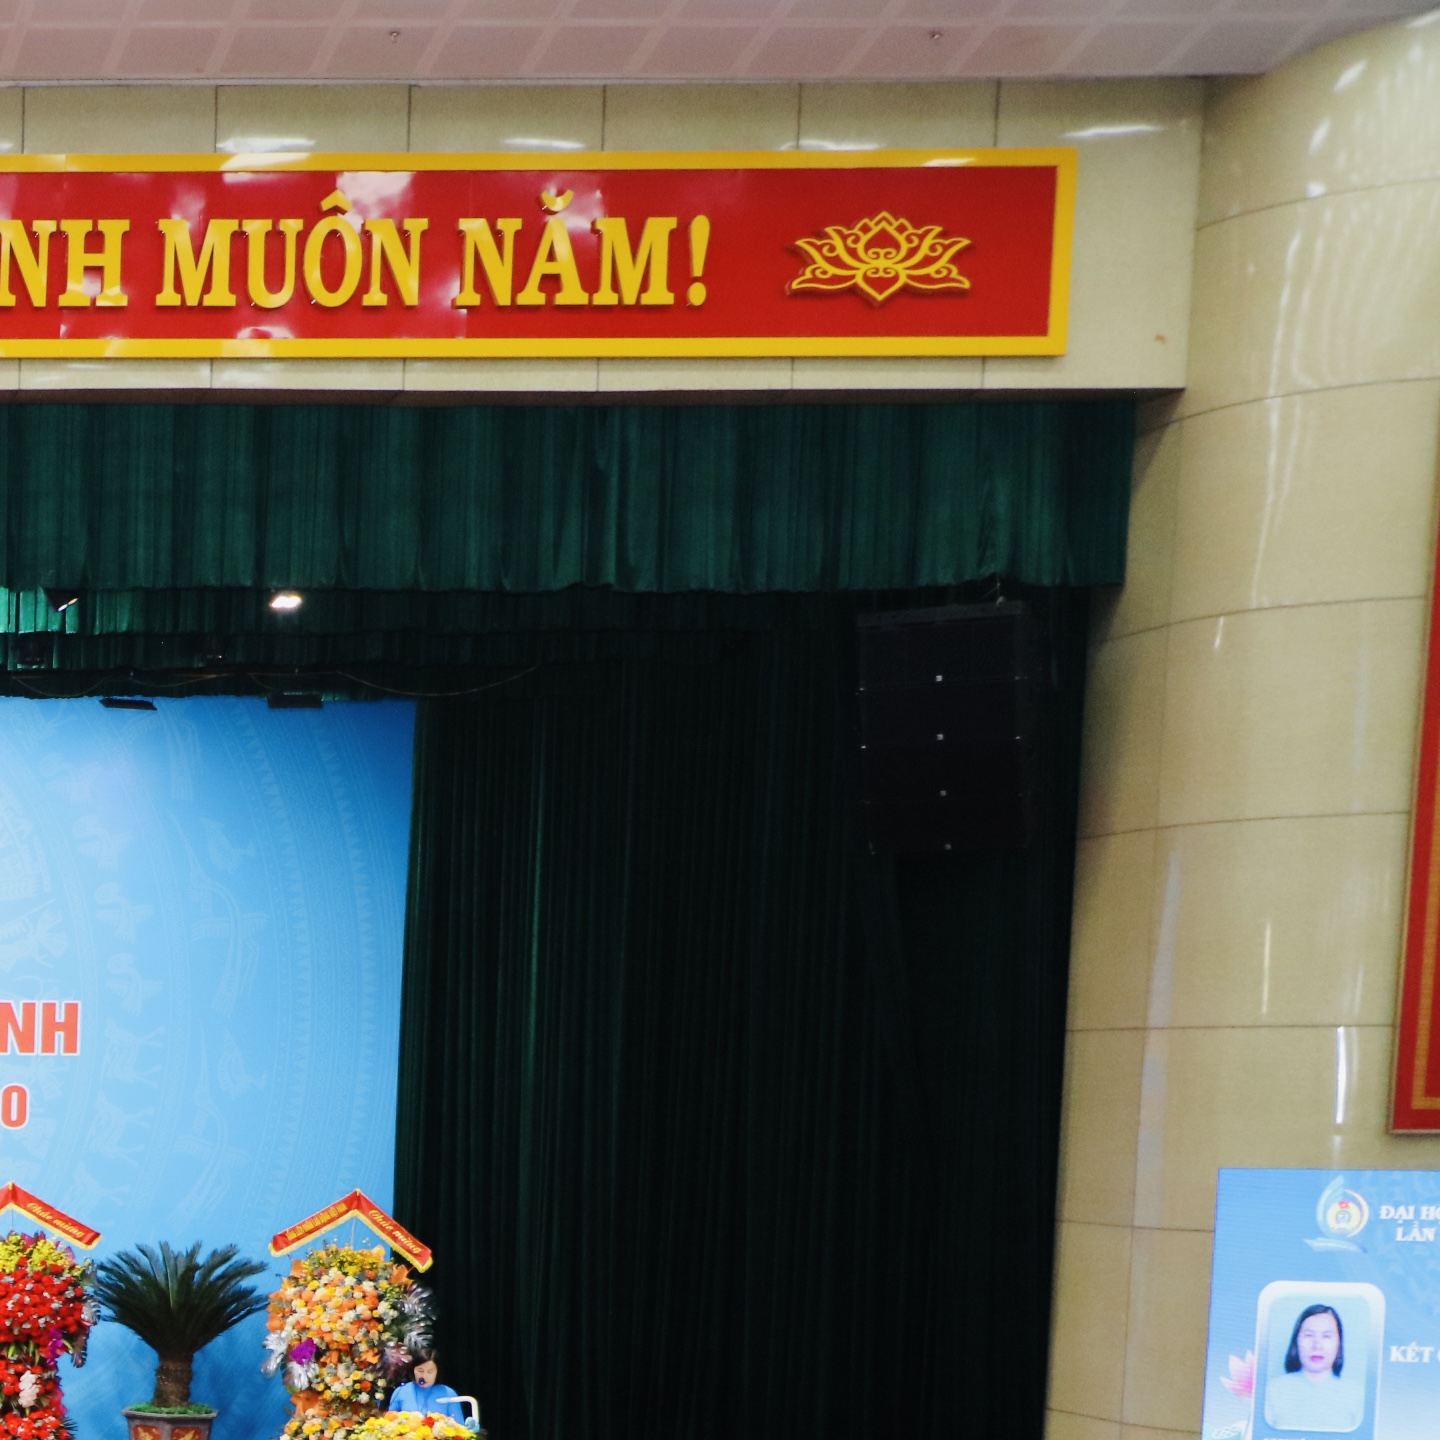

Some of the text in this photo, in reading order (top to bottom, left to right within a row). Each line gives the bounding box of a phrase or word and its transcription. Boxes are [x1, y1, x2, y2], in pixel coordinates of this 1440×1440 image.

[154, 191, 424, 310] MUÔN
[452, 188, 712, 308] NĂM!
[1379, 1204, 1415, 1224] ĐẠI
